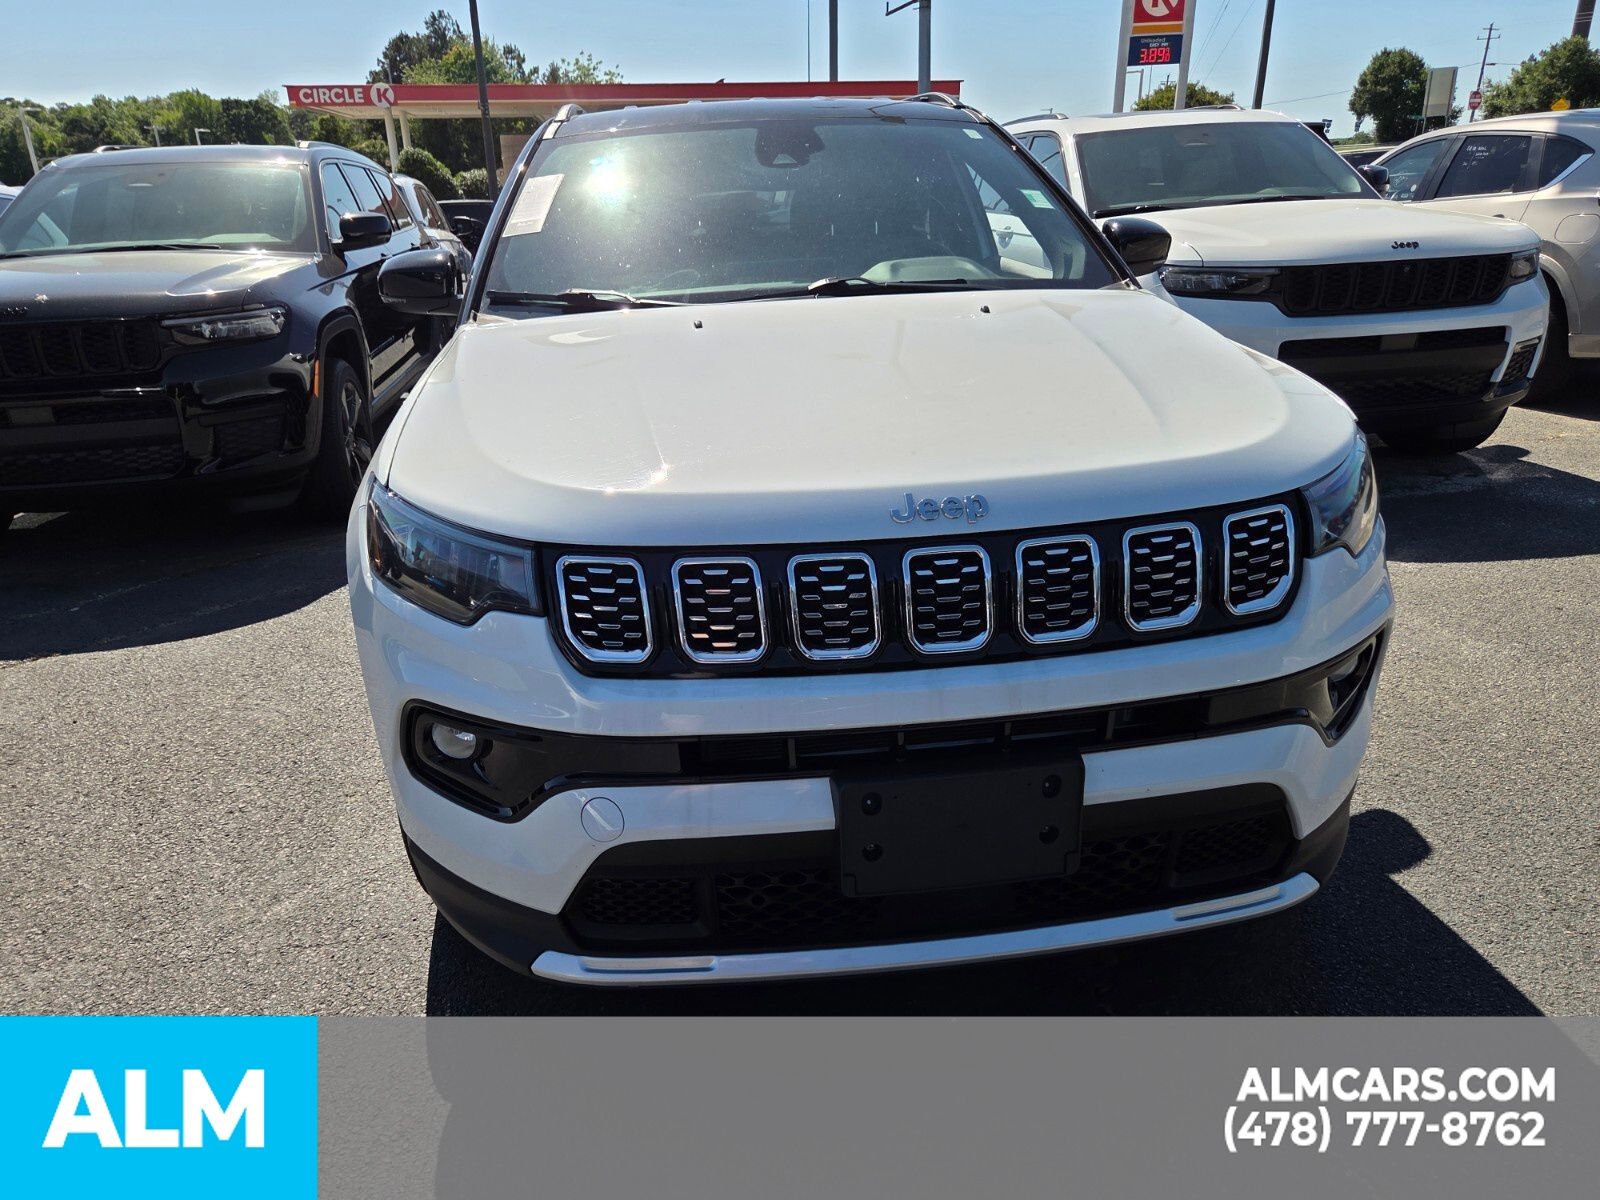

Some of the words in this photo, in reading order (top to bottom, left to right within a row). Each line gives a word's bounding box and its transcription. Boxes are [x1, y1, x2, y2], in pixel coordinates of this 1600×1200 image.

[299, 88, 364, 103] CIRCLE
[374, 86, 394, 107] K
[1391, 241, 1419, 249] Jeep
[890, 493, 990, 524] Jeep
